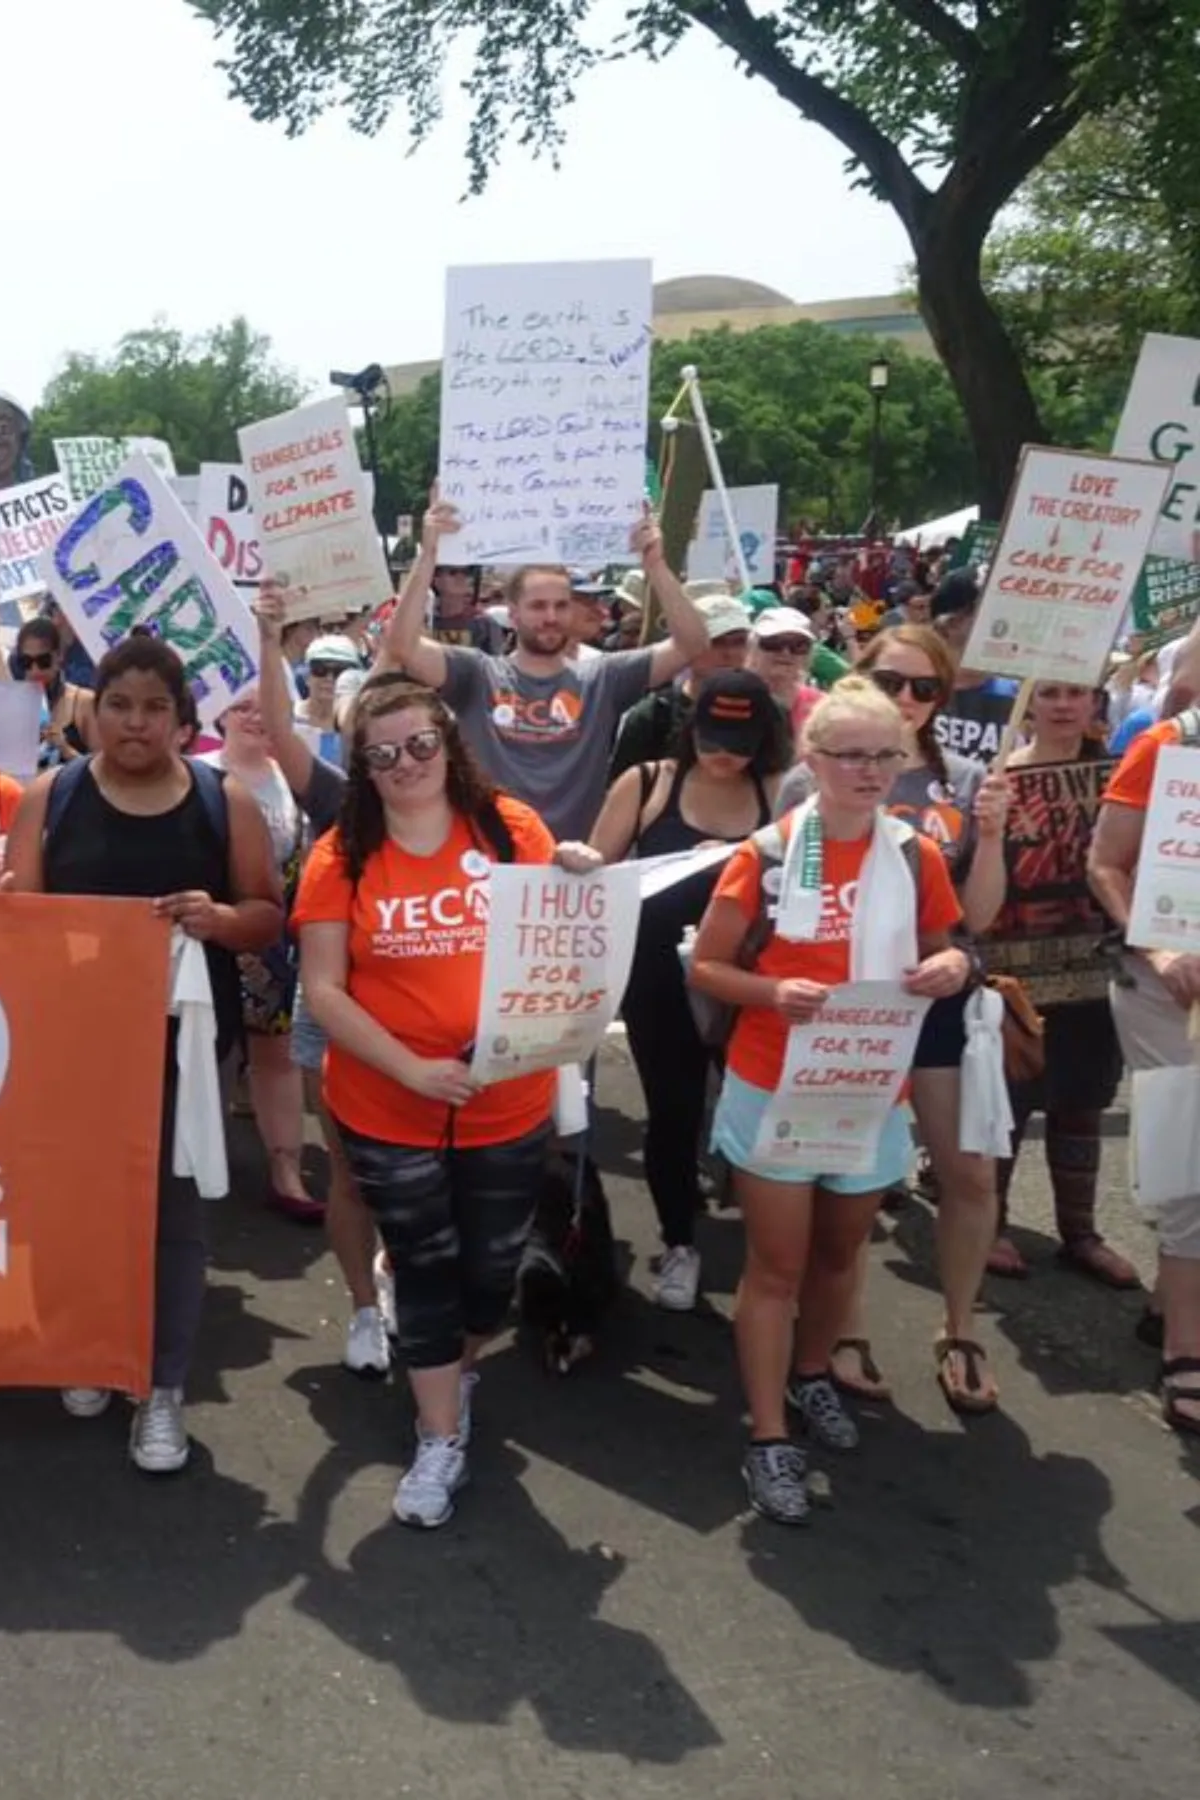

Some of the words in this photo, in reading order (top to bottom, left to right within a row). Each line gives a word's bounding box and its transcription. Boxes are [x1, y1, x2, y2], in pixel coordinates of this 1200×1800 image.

[264, 476, 298, 497] FOR
[299, 463, 338, 487] THE
[1069, 472, 1120, 498] LOVE
[262, 489, 356, 532] CLIMATE
[1028, 494, 1057, 519] THE
[1009, 550, 1074, 573] CARE
[1078, 557, 1126, 581] FOR
[999, 574, 1122, 605] CREATION
[539, 884, 606, 921] HUG
[514, 923, 608, 960] TREES
[526, 964, 584, 983] FOR
[497, 988, 608, 1014] JESUS
[810, 1036, 850, 1053] FOR
[855, 1037, 894, 1056] THE
[791, 1068, 897, 1087] CLIMATE
